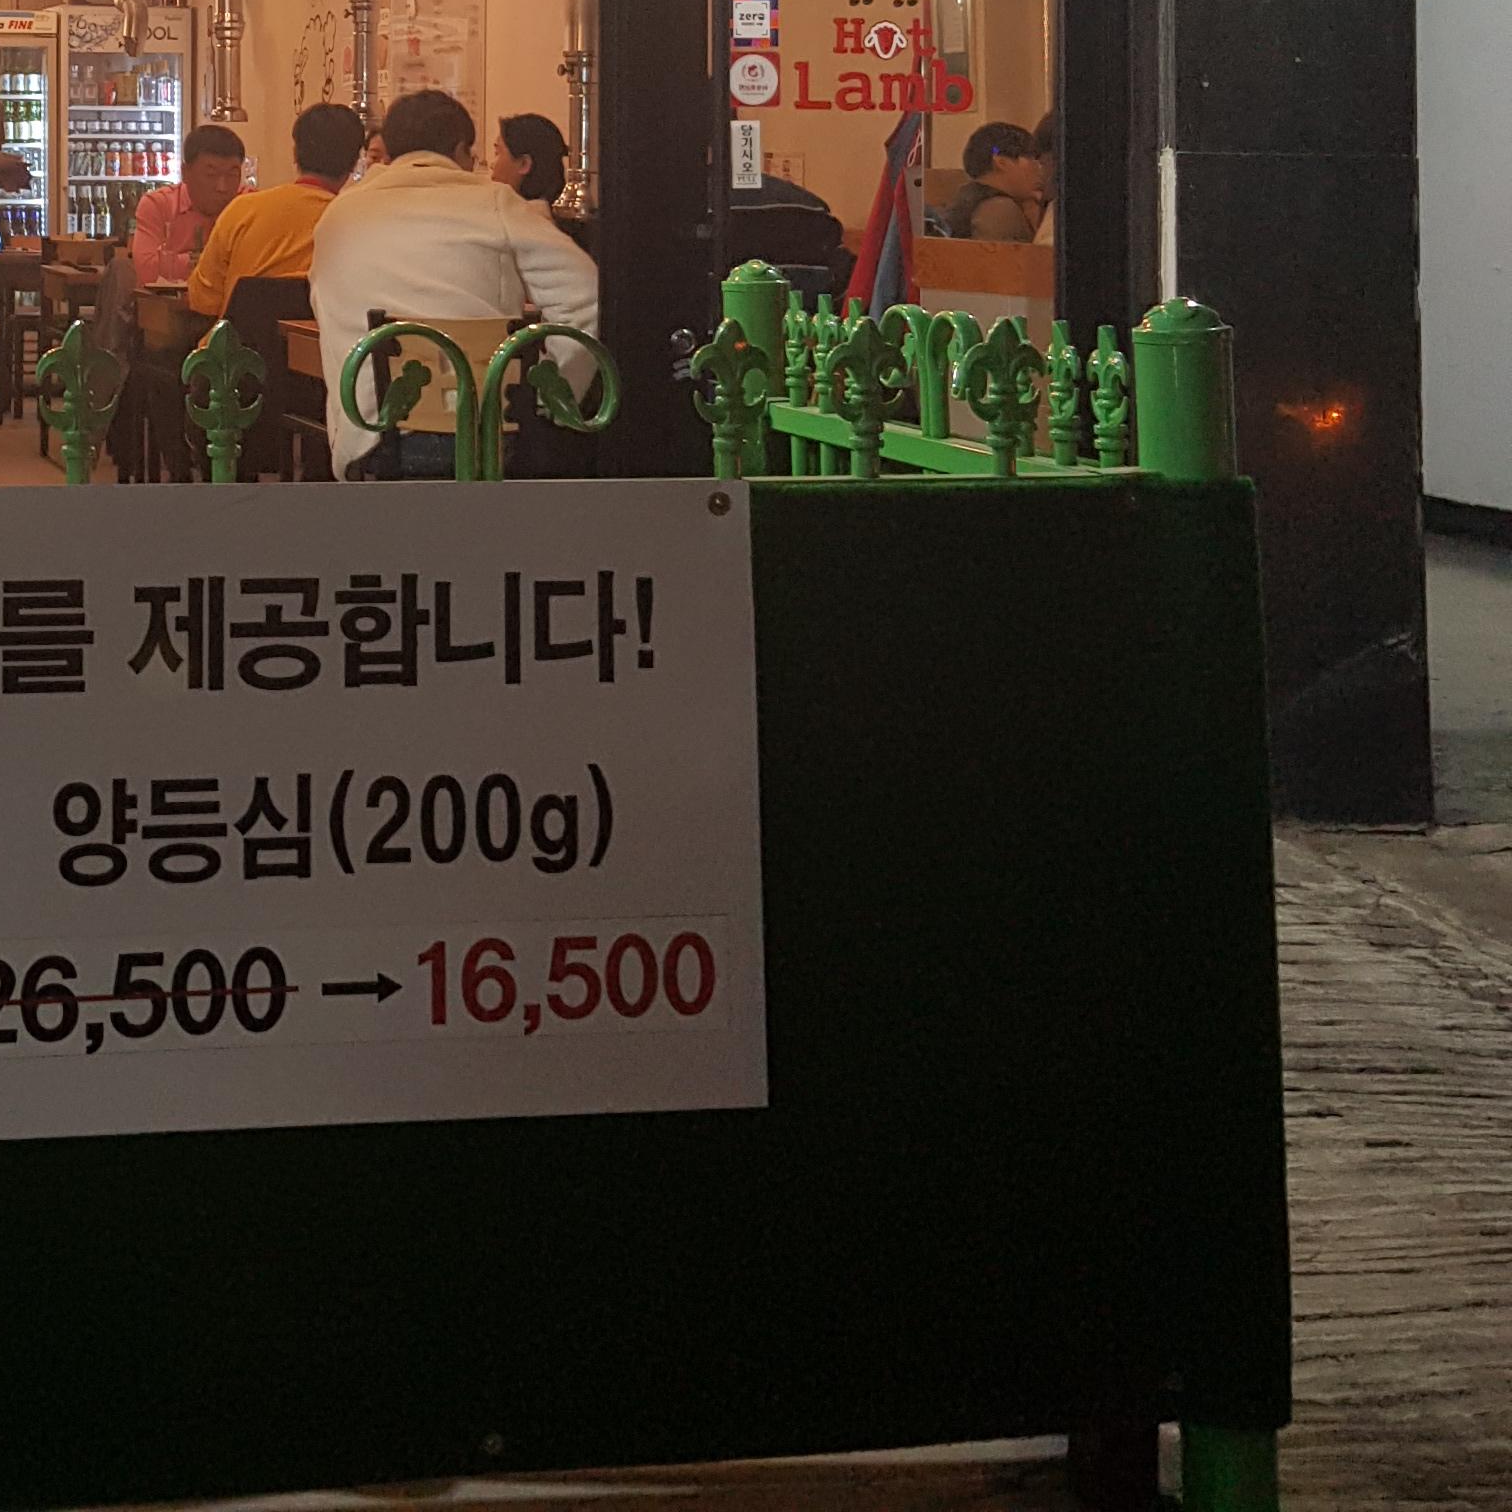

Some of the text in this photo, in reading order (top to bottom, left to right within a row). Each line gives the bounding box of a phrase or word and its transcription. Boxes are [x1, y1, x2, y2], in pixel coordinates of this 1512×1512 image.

[7, 19, 34, 30] FINE
[793, 58, 975, 112] Lamb
[740, 124, 754, 173] 당기시오
[128, 571, 653, 690] 제공합니다!
[54, 764, 613, 886] 양등심(200g)
[418, 932, 715, 1036] 16,500
